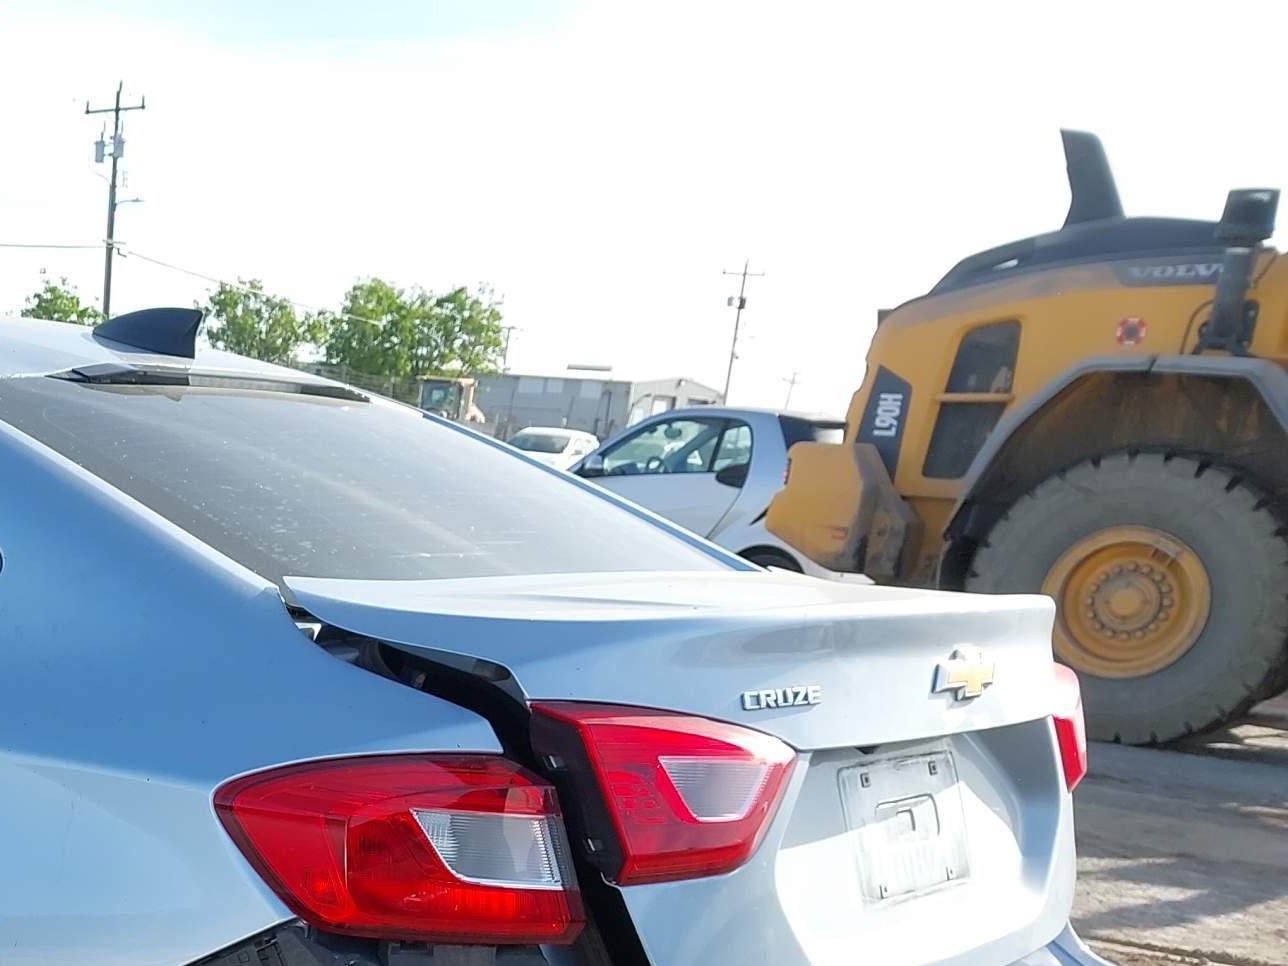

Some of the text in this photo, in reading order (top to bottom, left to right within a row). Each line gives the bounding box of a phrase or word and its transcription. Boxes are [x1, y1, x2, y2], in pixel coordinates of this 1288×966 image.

[1128, 263, 1224, 278] VOLV
[873, 393, 903, 437] L90H
[742, 685, 822, 710] CRUZE
